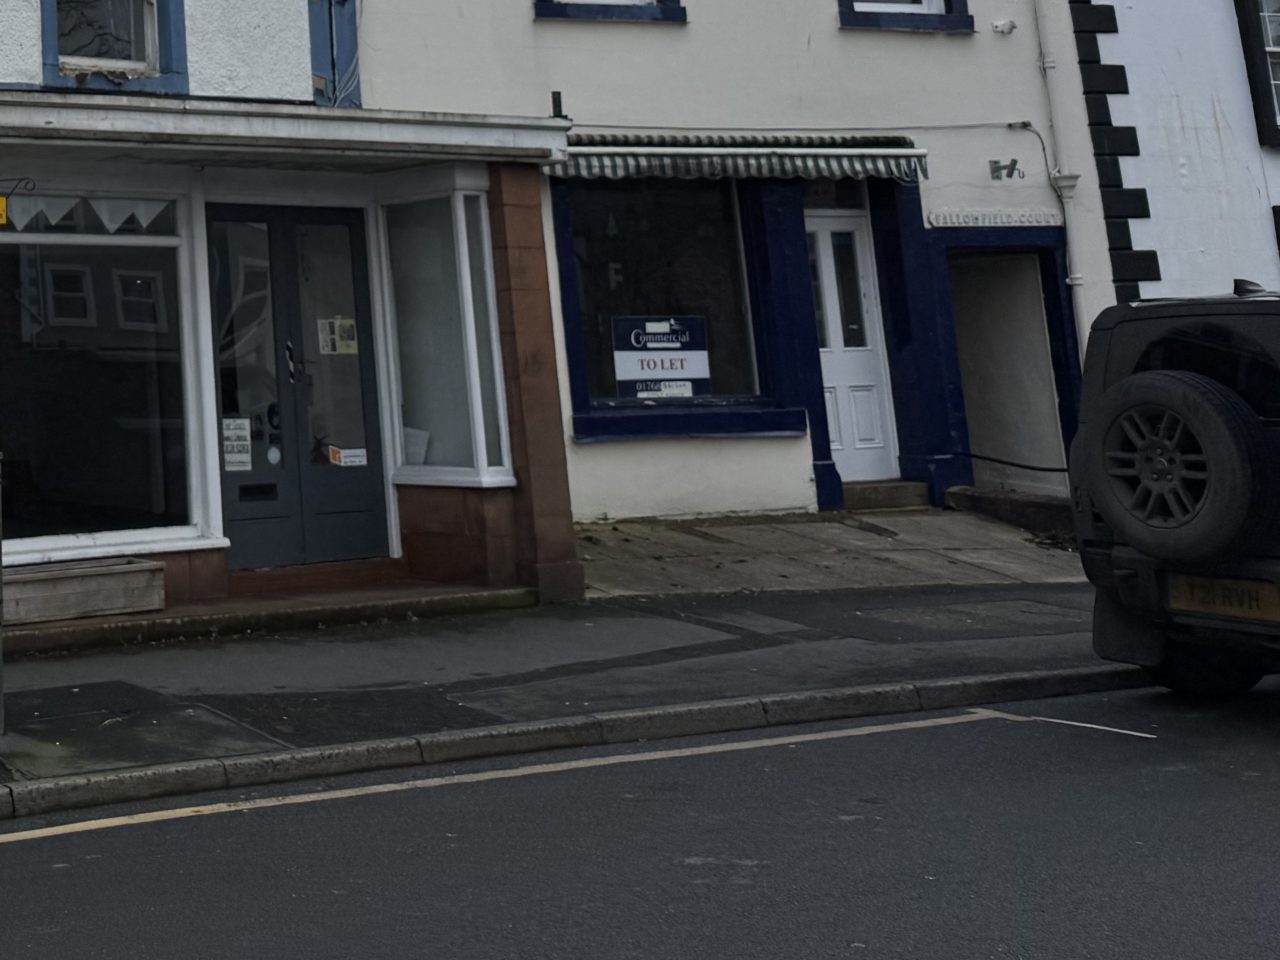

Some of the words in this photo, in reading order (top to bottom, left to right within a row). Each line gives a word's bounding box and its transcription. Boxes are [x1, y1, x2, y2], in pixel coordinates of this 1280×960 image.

[631, 328, 690, 348] Commercial
[637, 358, 657, 371] TO
[660, 357, 687, 371] LET
